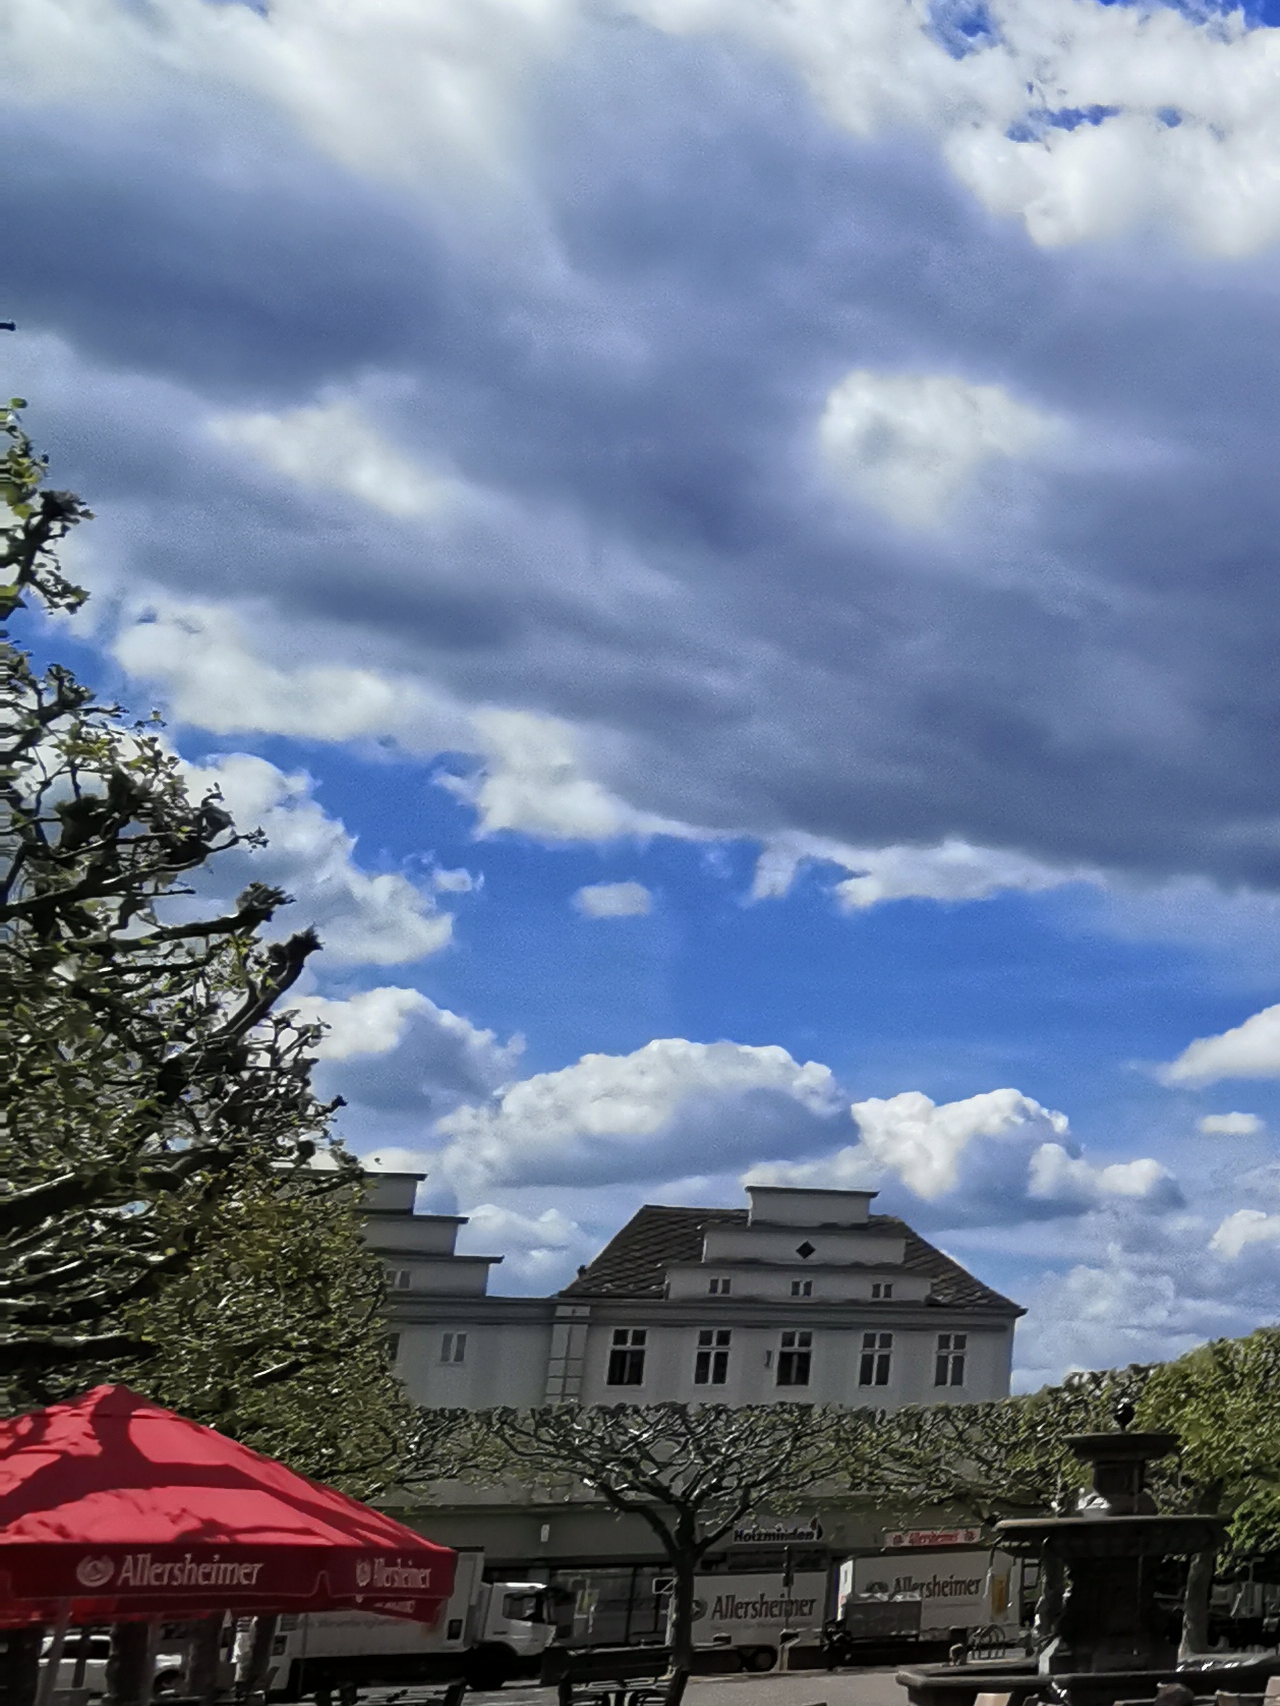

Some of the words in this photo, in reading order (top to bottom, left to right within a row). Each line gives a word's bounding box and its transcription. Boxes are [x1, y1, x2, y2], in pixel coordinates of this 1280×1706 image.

[116, 1552, 265, 1587] Allersheimer
[887, 1573, 983, 1600] Allersheimer
[711, 1592, 818, 1621] Allersheimer
